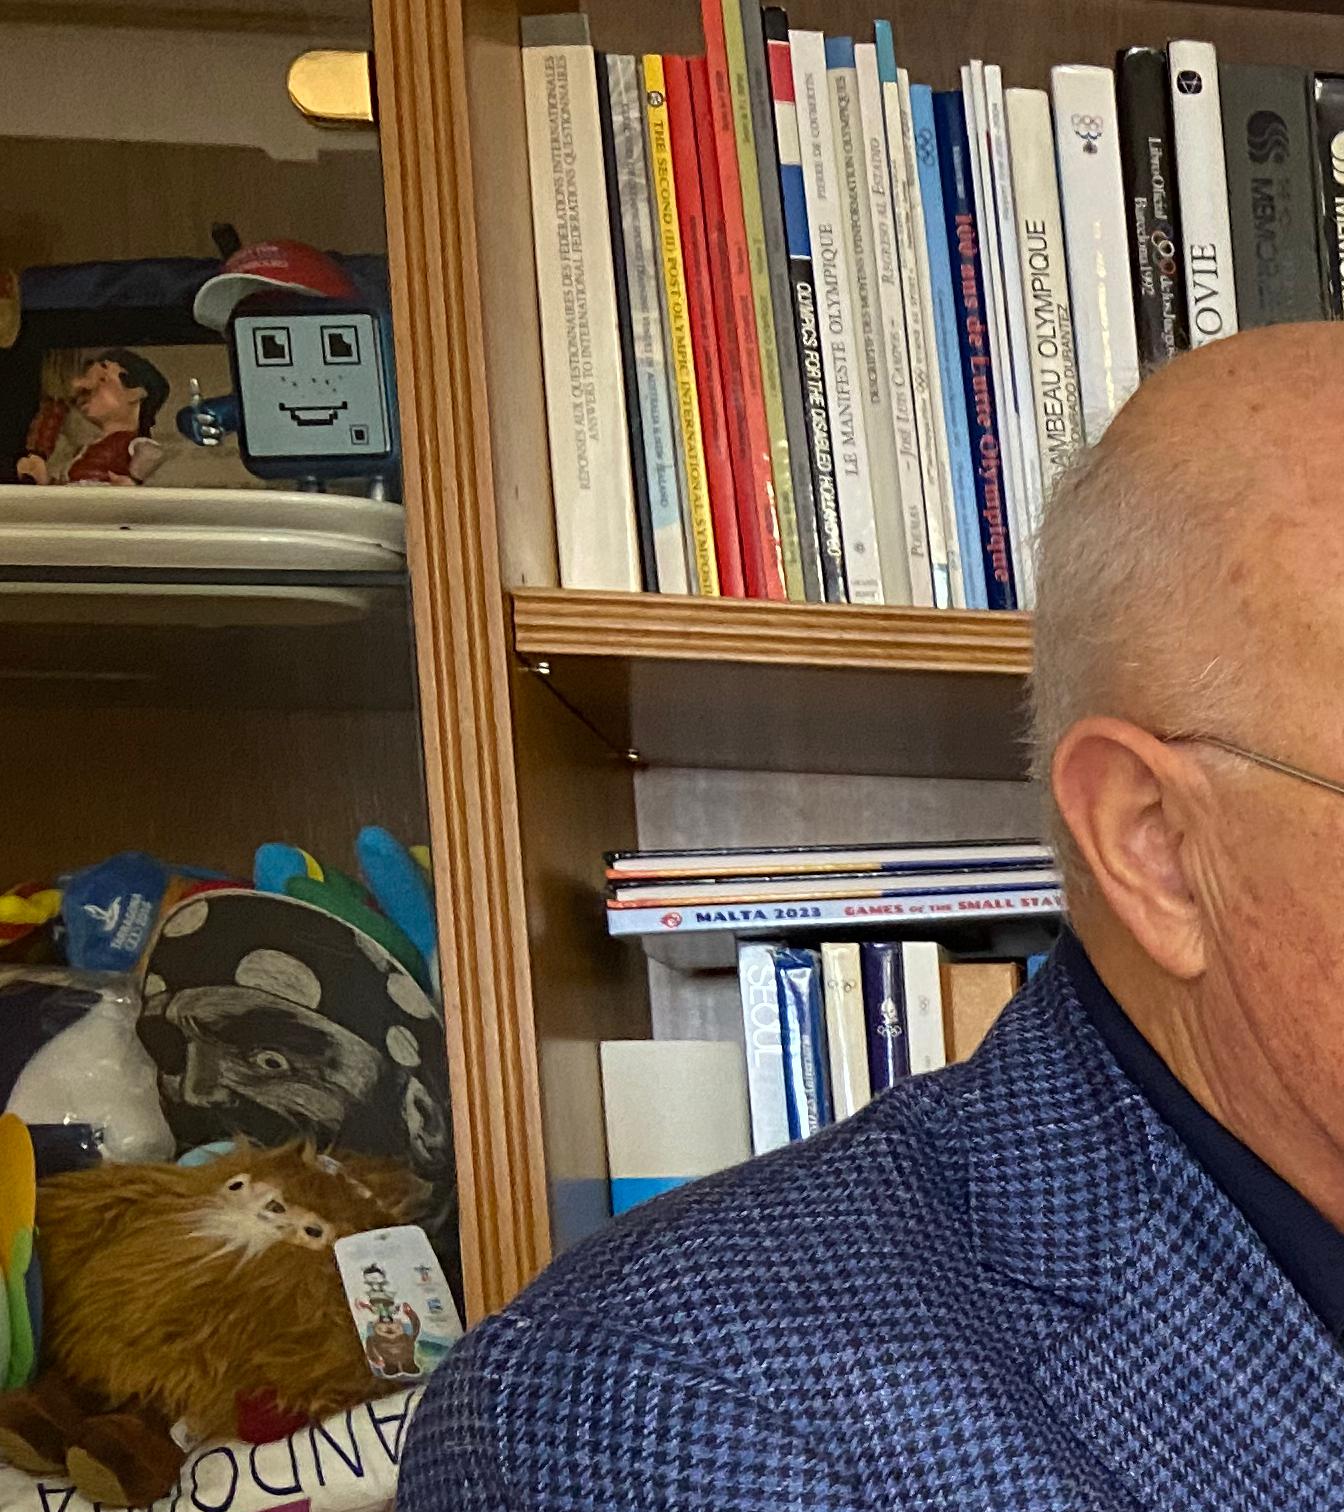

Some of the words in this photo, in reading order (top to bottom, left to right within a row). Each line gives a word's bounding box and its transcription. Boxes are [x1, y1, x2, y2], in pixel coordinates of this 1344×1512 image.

[654, 120, 666, 149] THE
[811, 143, 821, 158] DE
[1147, 135, 1164, 175] Libro
[657, 158, 673, 224] SECOND
[871, 198, 887, 215] AL
[1151, 175, 1169, 220] Oficial
[953, 213, 977, 258] 100
[1133, 196, 1152, 262] Barcelona
[561, 263, 573, 287] DES
[667, 256, 681, 296] POST
[817, 223, 844, 335] OLYMPIQUE
[958, 262, 979, 310] ans
[1025, 217, 1058, 359] OLYMPIQUE
[1139, 262, 1155, 295] 1992
[572, 256, 591, 356] INTERNATIONAL
[795, 281, 818, 346] OLYMPICS
[672, 303, 688, 371] OLYMPIC
[964, 313, 986, 347] de
[581, 360, 593, 376] TO
[803, 348, 821, 378] FOR
[582, 381, 598, 440] ANSWERS
[807, 378, 823, 407] THE
[830, 340, 855, 447] MANIFESTE
[680, 379, 701, 511] INTERNATIONAL
[809, 407, 831, 471] DISABLED
[843, 453, 859, 476] LE
[973, 431, 1015, 582] Olympique
[695, 908, 767, 924] MALTA
[774, 907, 823, 920] 2023
[844, 904, 904, 918] GAMES
[958, 897, 1014, 912] SMALL
[747, 964, 784, 1068] SEOUL
